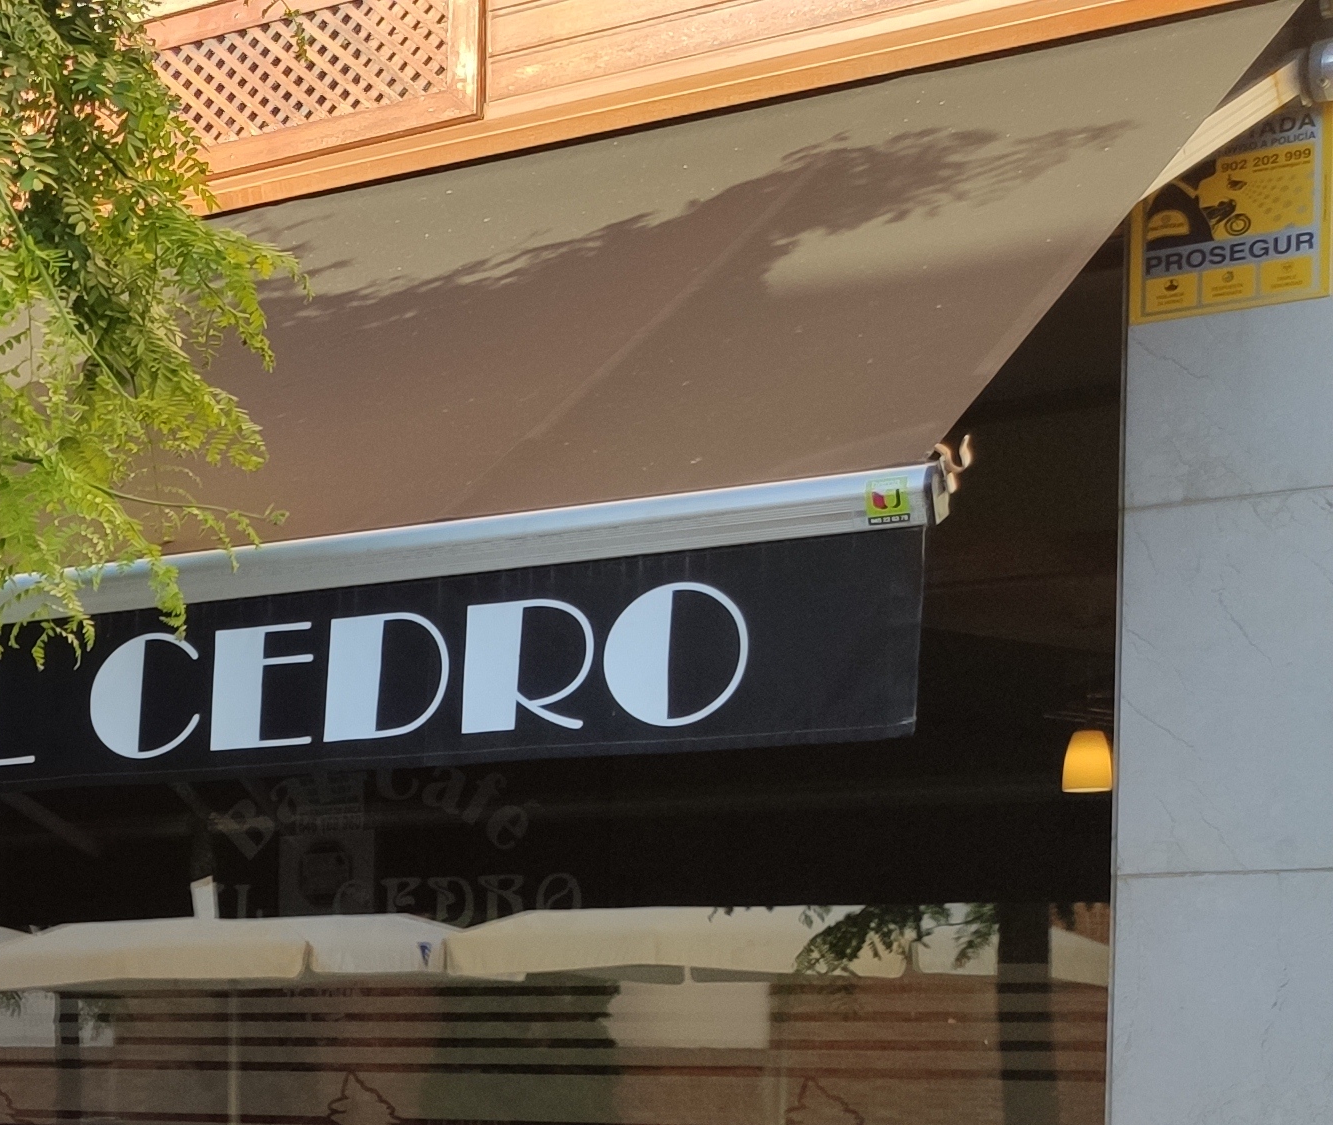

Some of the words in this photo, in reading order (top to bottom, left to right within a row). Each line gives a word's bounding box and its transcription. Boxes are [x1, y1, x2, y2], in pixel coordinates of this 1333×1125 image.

[1221, 159, 1248, 173] 902
[1252, 153, 1279, 169] 202
[1284, 148, 1311, 162] 999
[1146, 231, 1314, 276] PROSEGUR
[89, 581, 749, 758] CEDRO
